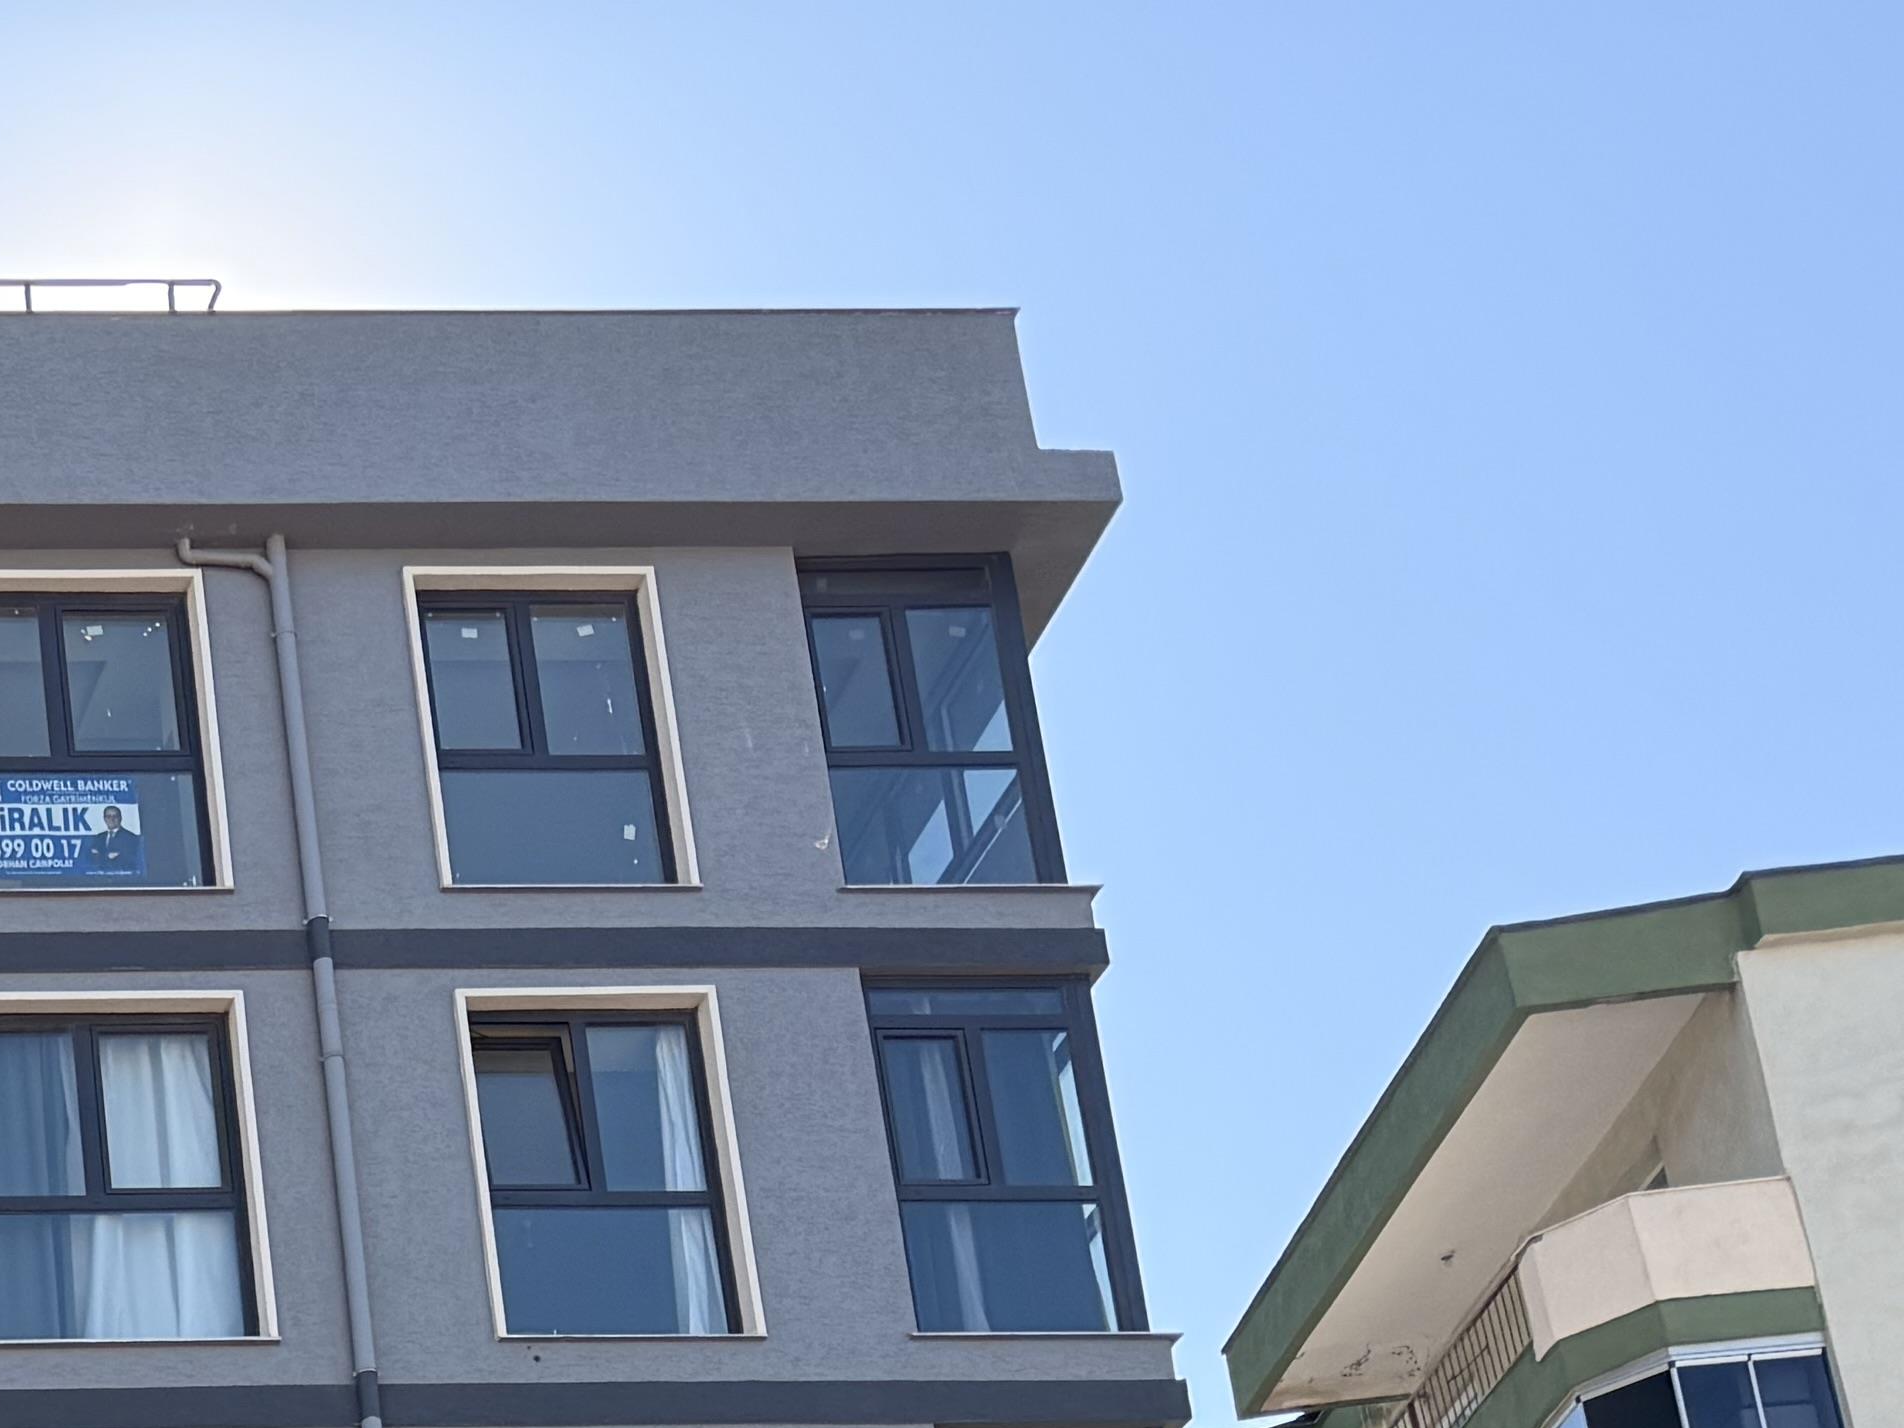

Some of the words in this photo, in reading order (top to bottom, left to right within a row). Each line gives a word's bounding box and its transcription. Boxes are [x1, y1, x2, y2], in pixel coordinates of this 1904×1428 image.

[7, 779, 74, 791] COLDWELL
[77, 779, 128, 791] BANKER
[30, 838, 54, 858] 00
[60, 839, 82, 858] 17
